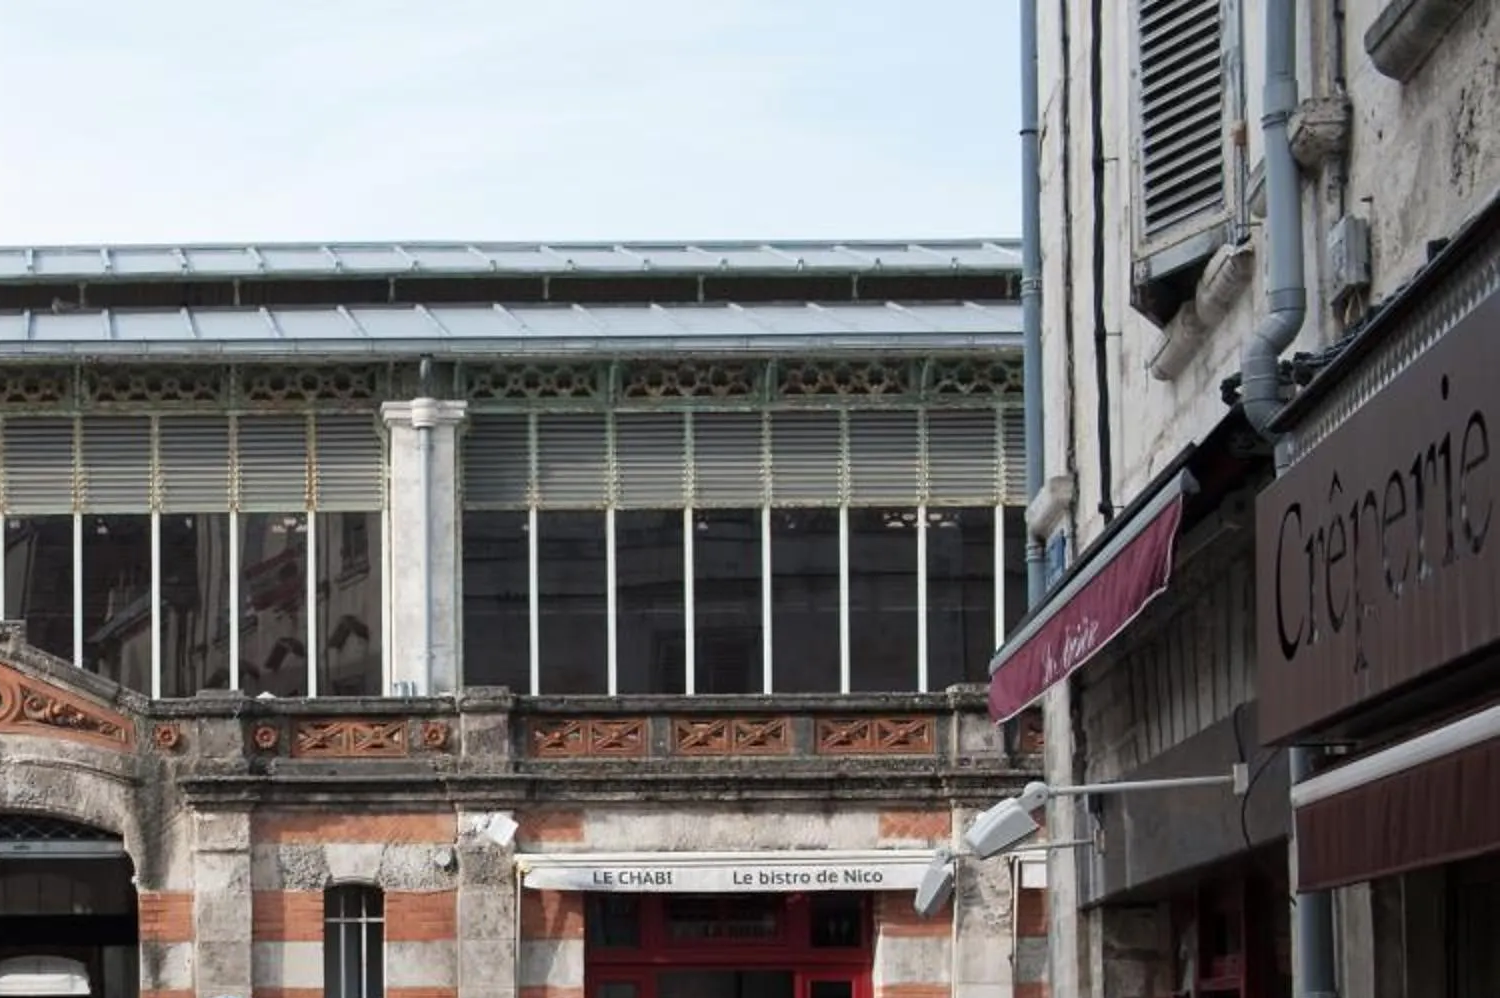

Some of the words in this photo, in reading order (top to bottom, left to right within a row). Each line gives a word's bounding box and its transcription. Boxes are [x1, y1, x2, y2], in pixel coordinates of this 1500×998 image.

[1275, 373, 1493, 674] Crêperie
[593, 871, 613, 885] LE
[619, 871, 673, 885] CHABI
[733, 871, 753, 885] Le
[759, 870, 811, 885] bistro
[816, 870, 839, 884] de
[843, 869, 884, 883] Nico
